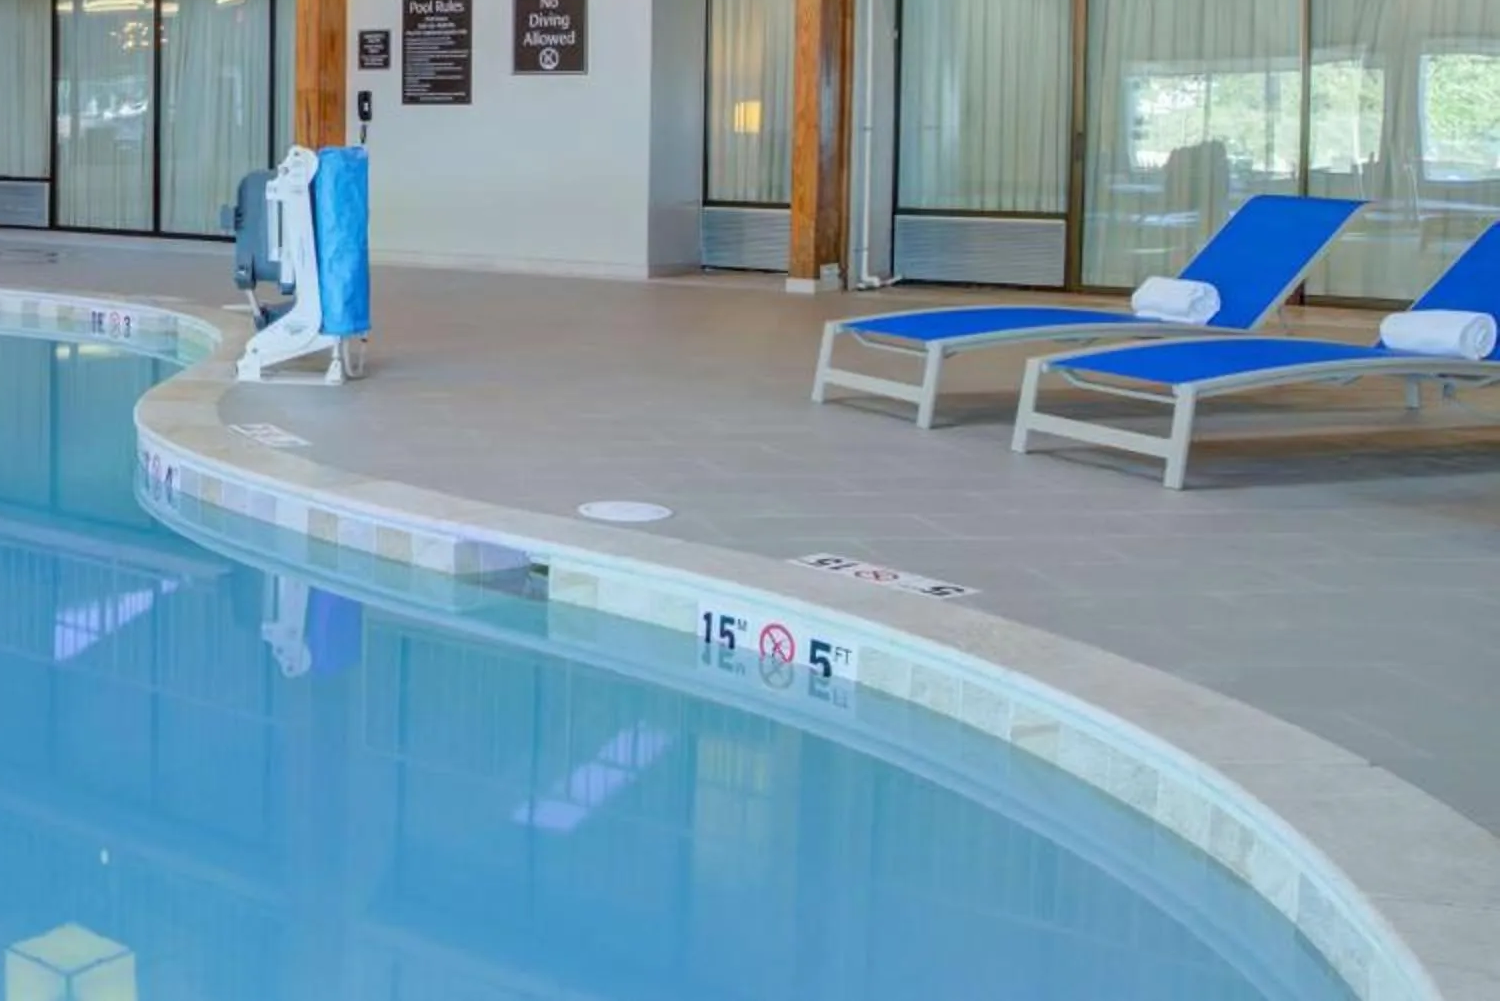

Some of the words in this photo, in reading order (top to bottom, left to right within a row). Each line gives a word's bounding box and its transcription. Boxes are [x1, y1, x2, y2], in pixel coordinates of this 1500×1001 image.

[409, 0, 433, 14] Pool
[435, 0, 465, 13] Rules
[528, 12, 571, 30] Diving
[522, 30, 576, 47] Allowed
